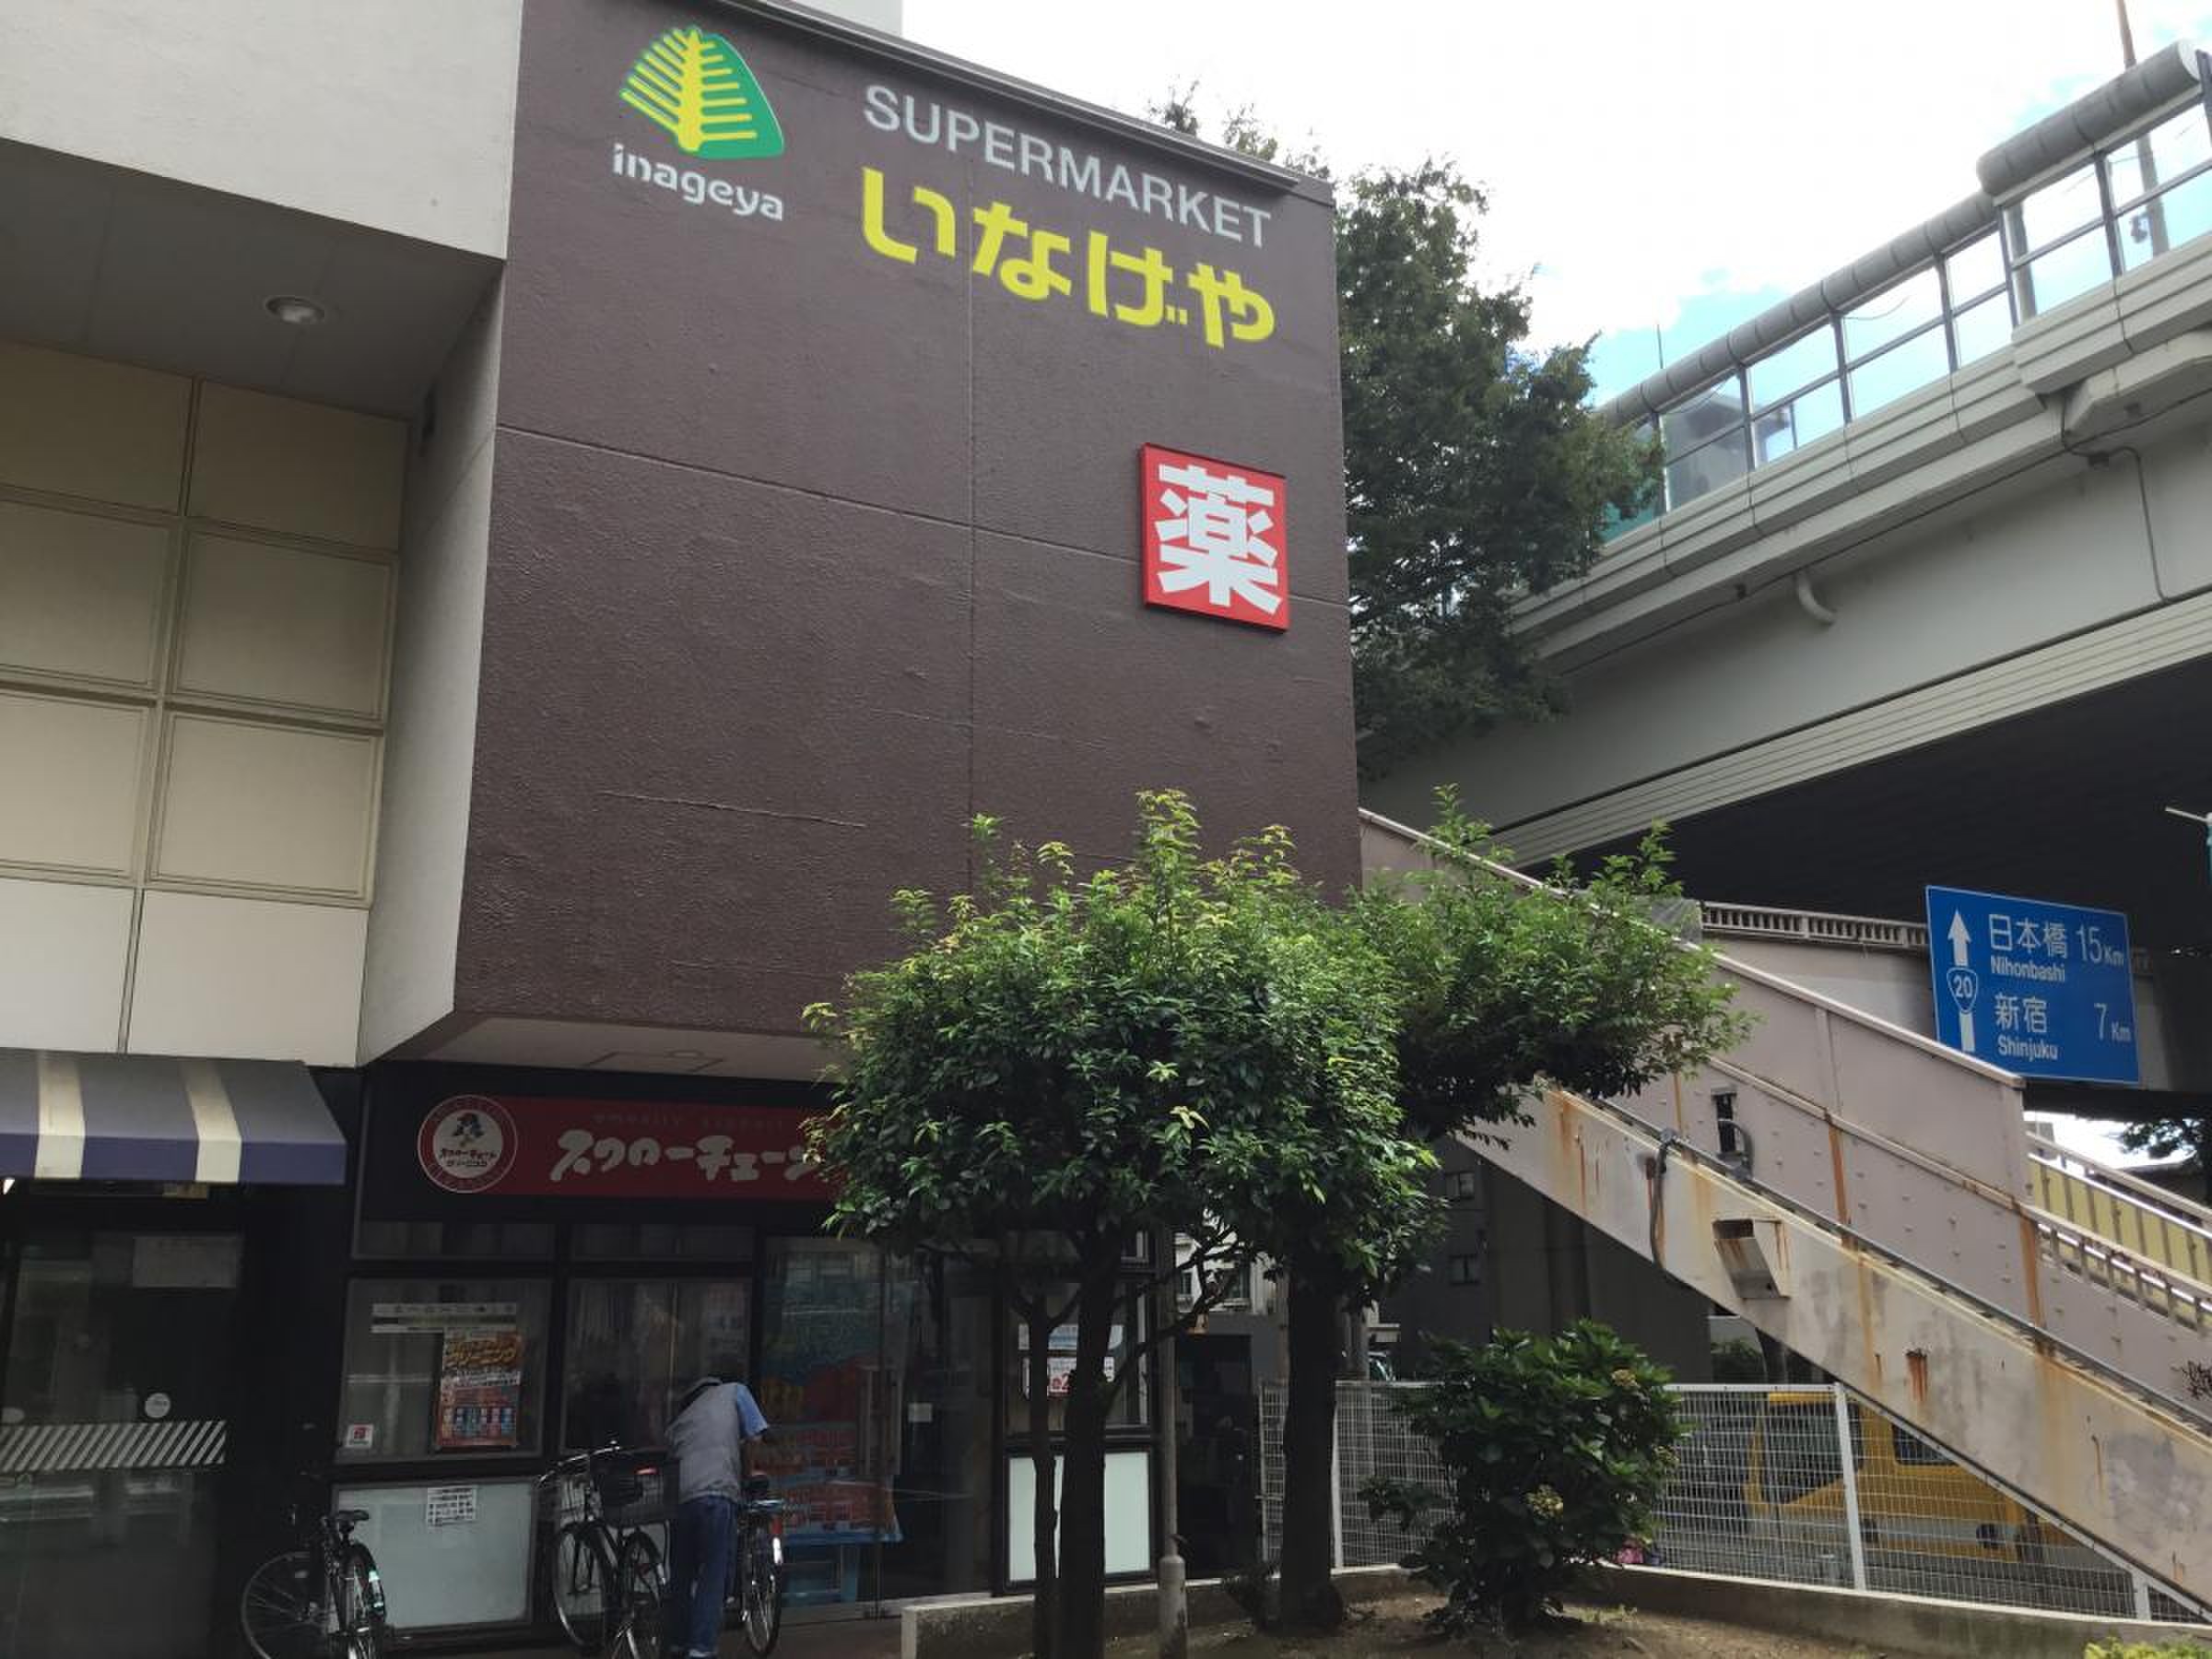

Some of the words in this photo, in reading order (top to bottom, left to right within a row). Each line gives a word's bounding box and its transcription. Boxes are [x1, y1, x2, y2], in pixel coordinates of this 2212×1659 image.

[611, 143, 784, 221] inageya
[864, 85, 1272, 249] SUPERMARKET
[862, 166, 1277, 348] いなげや
[1155, 464, 1282, 615] 薬
[1988, 913, 2068, 959] 日本橋
[1952, 975, 1973, 998] 20
[1990, 955, 2065, 982] Nihonbashi
[1994, 992, 2049, 1033] 新宿
[1997, 1035, 2058, 1062] Shinjuku
